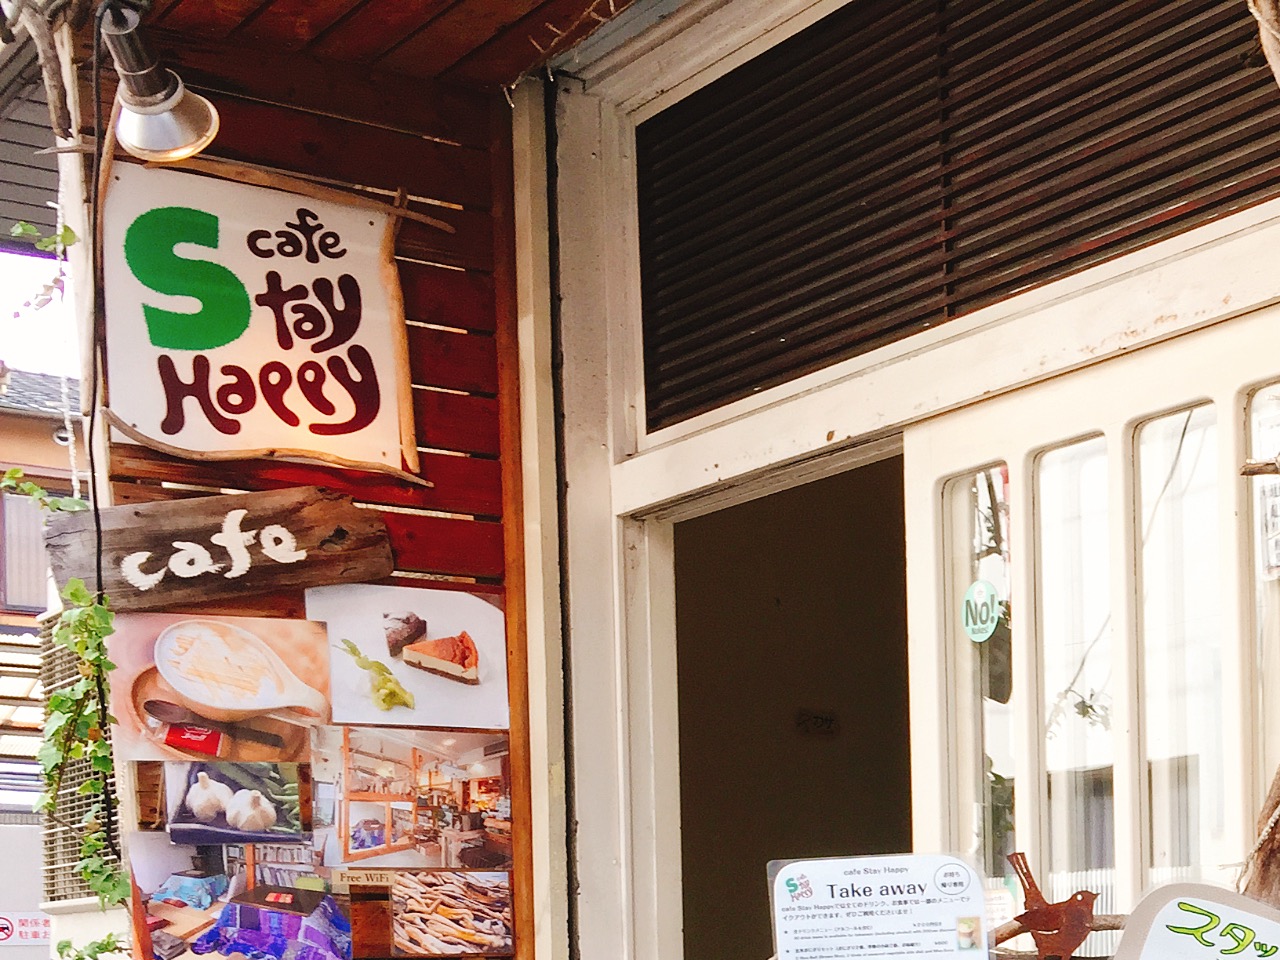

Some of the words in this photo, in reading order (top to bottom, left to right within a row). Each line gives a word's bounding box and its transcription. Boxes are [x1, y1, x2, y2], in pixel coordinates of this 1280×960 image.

[246, 208, 348, 264] cafe
[157, 344, 380, 436] Happy
[120, 509, 307, 591] cafe
[965, 594, 995, 627] No!
[340, 873, 361, 882] Free
[365, 873, 389, 882] WiFi
[826, 883, 872, 899] Take
[879, 883, 927, 896] away
